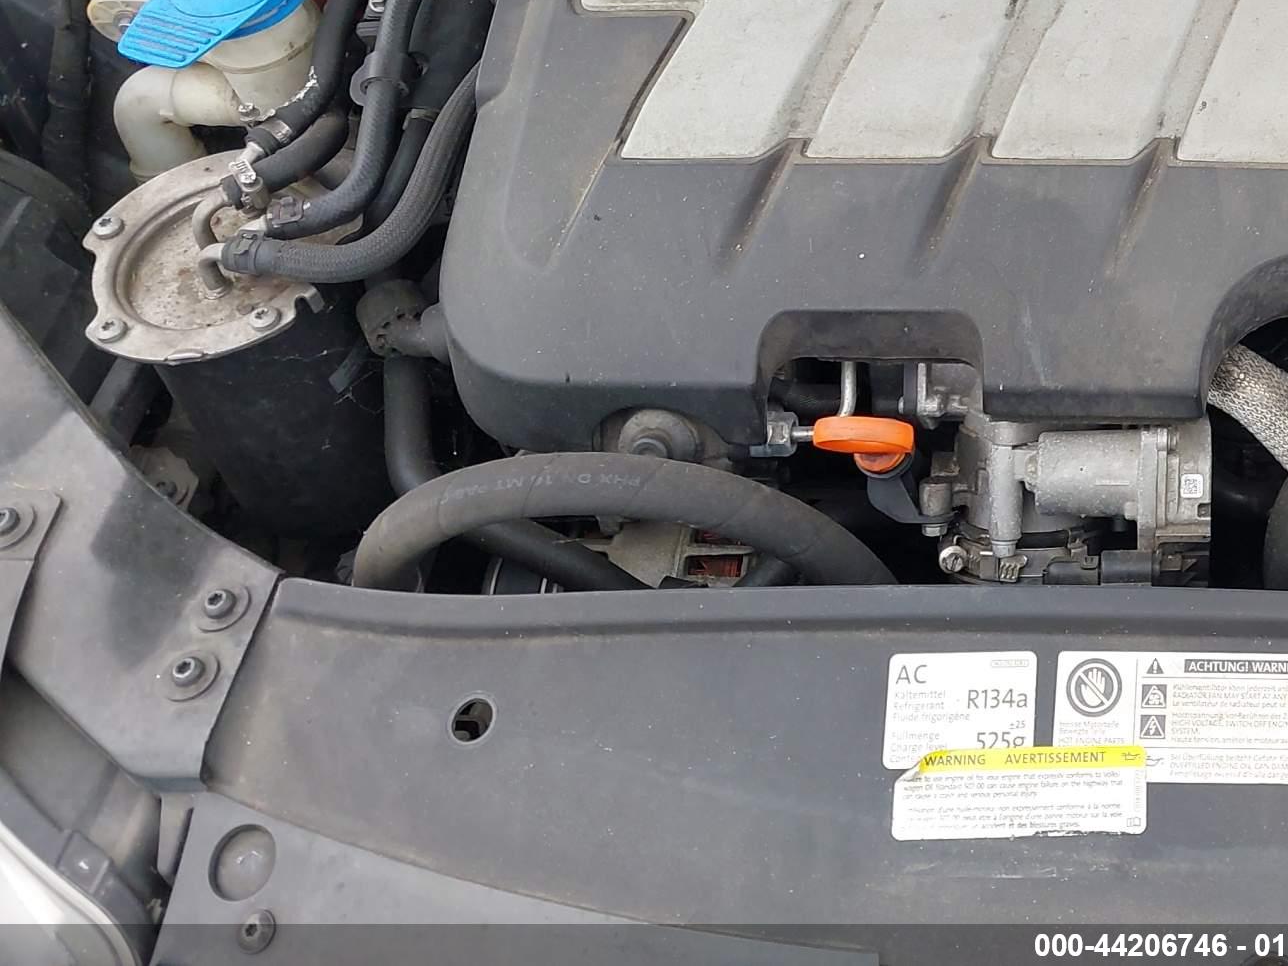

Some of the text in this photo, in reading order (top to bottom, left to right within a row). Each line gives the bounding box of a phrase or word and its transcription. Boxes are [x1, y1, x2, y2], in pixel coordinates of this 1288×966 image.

[895, 664, 928, 685] AC
[1188, 660, 1250, 674] ACHTUNG!
[967, 688, 1028, 709] R134a
[923, 751, 1108, 767] WARNING AVERTISSEMENT
